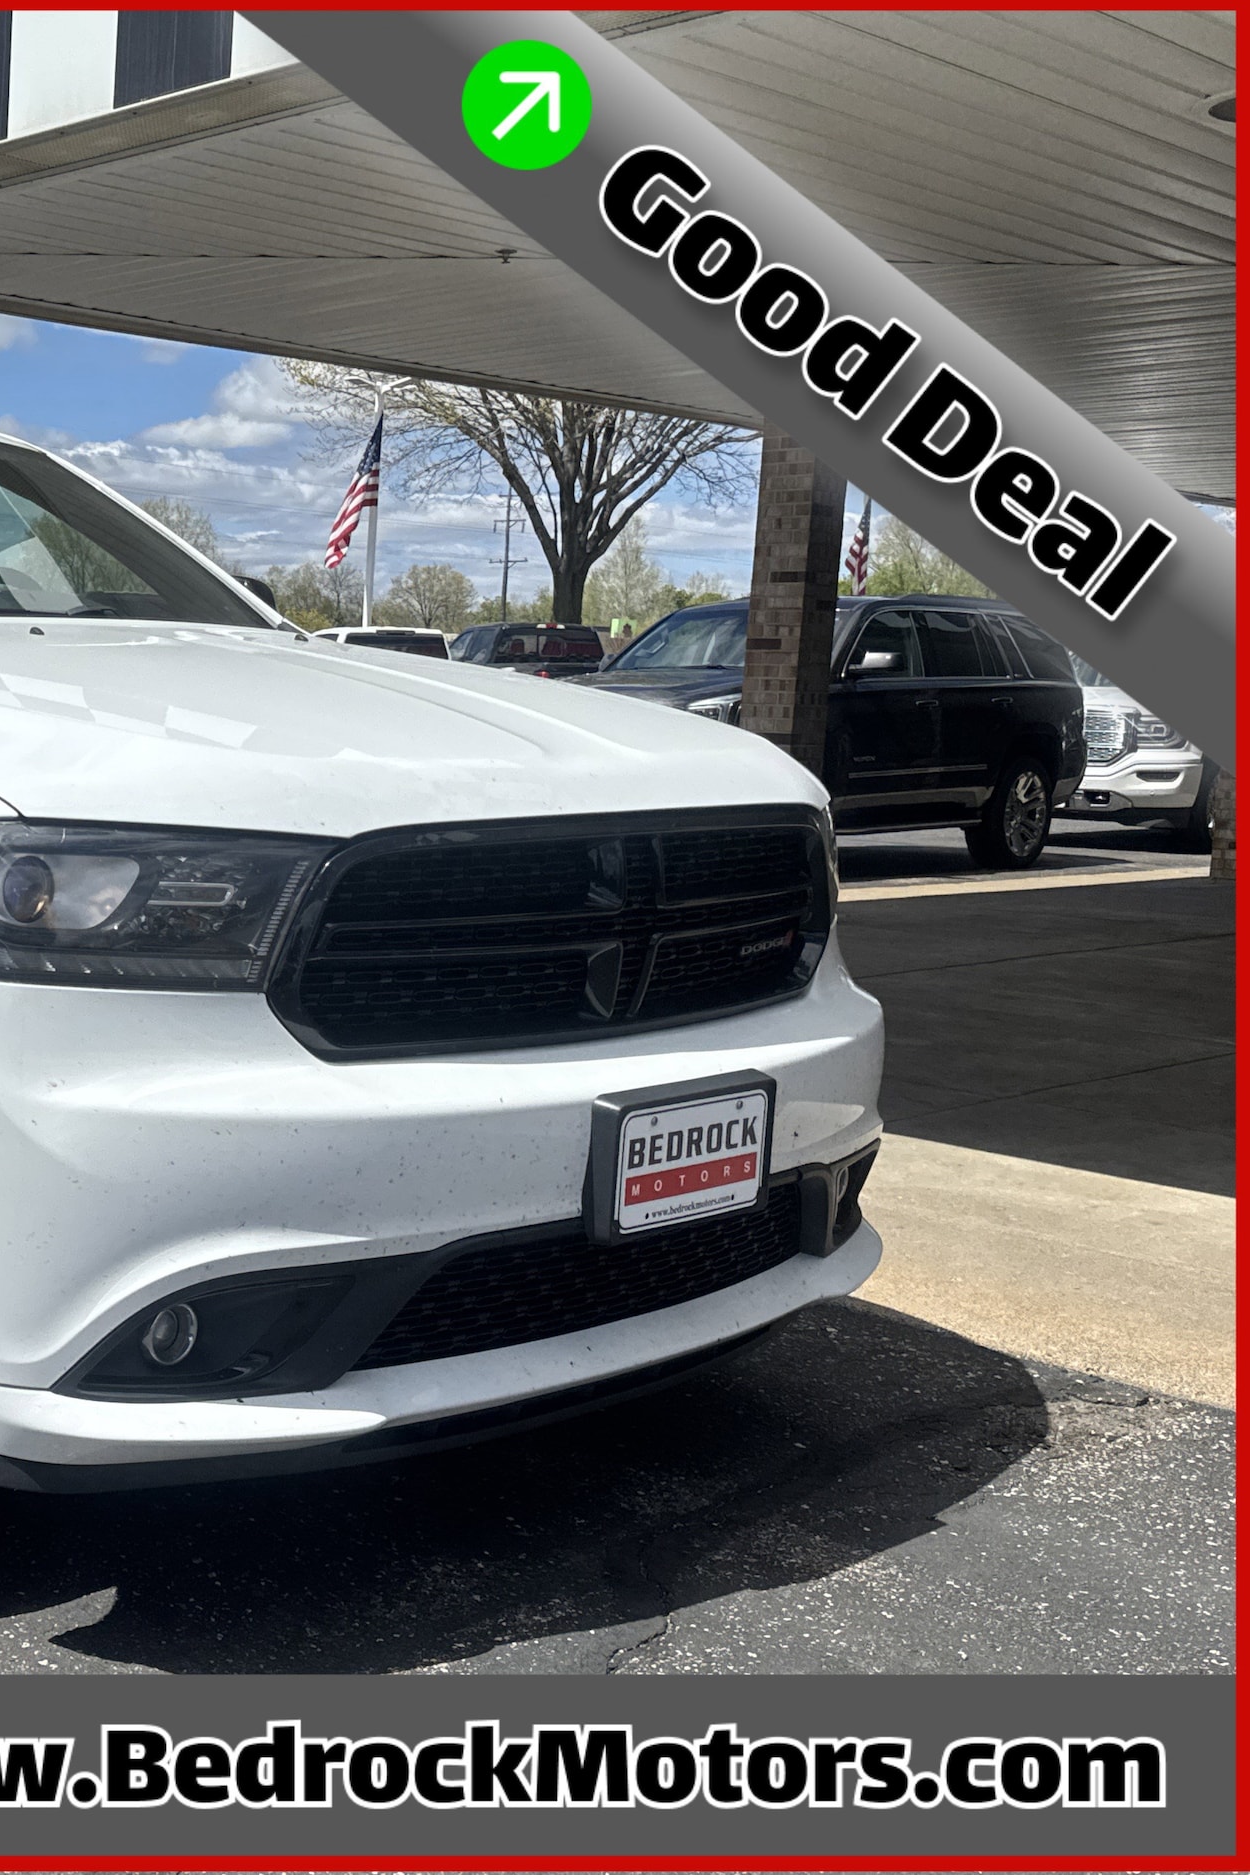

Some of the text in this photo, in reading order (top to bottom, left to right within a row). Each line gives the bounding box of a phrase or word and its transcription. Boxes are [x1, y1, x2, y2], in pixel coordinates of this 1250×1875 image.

[627, 1116, 758, 1170] BEDROCK
[631, 1160, 751, 1197] MOTORS
[651, 1194, 731, 1219] www.bedrockmotors.com
